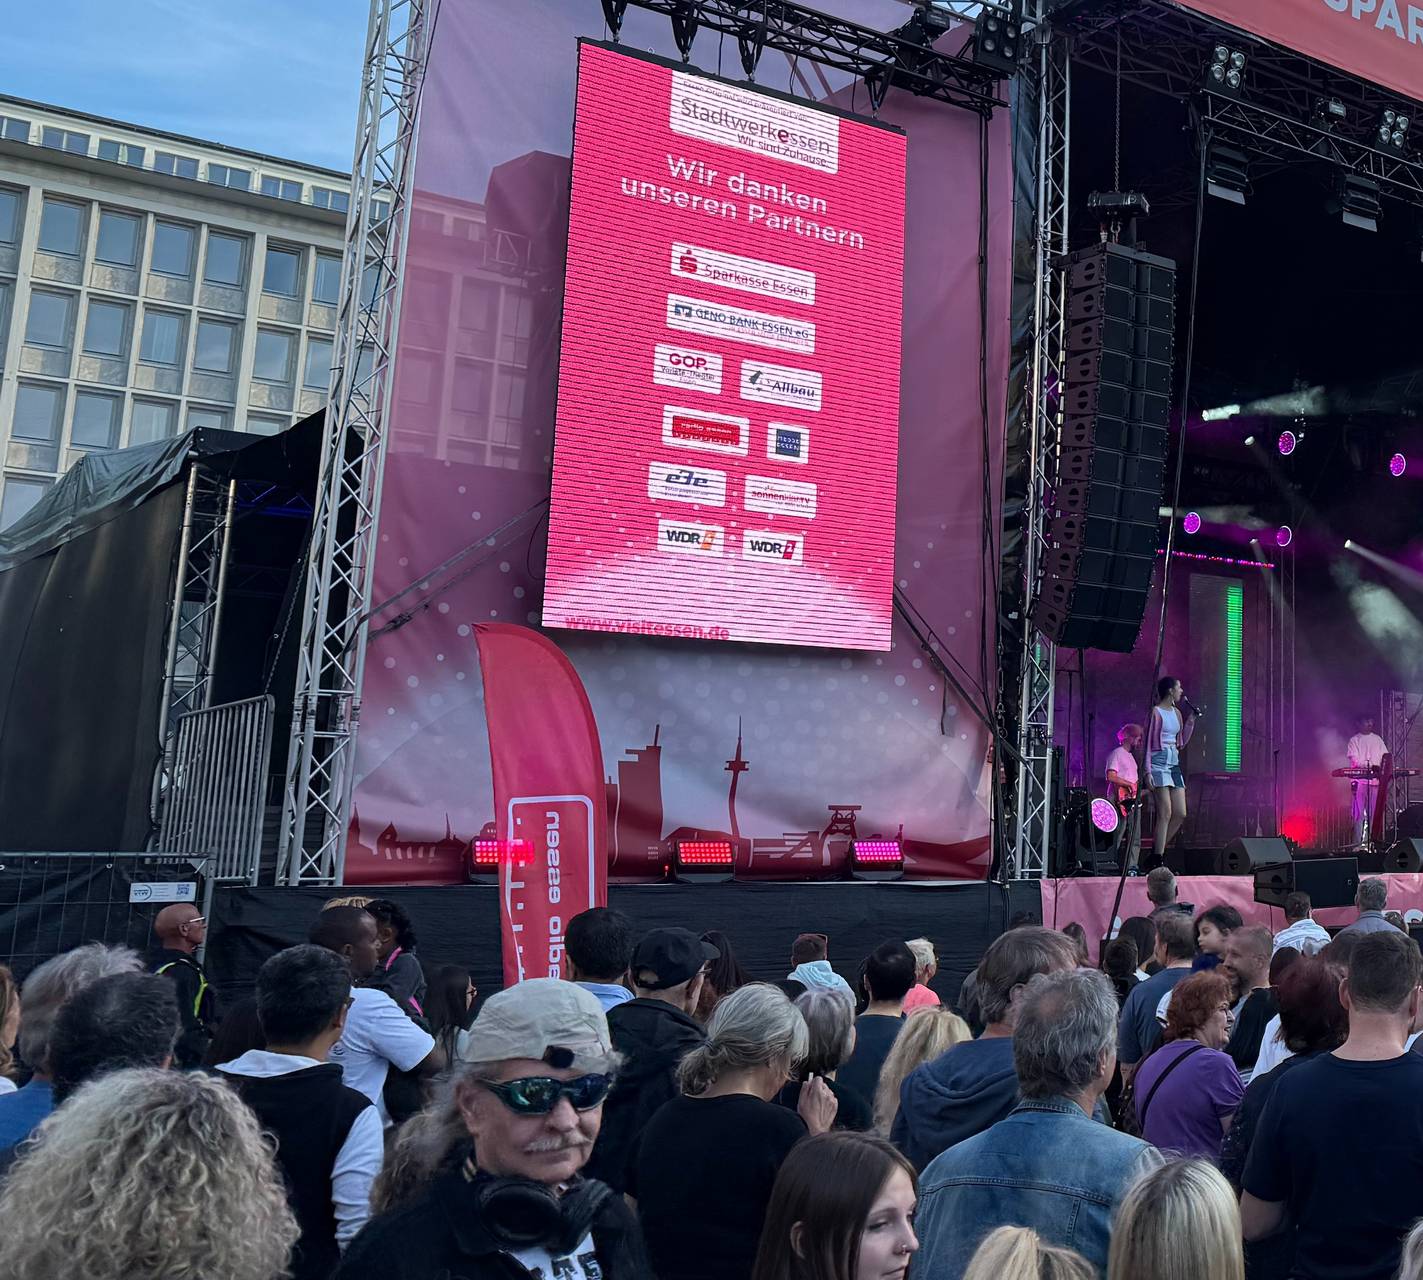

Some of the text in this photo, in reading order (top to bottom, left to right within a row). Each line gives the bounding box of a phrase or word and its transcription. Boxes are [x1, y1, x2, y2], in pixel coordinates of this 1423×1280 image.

[681, 98, 830, 154] Stadtwerkessen
[738, 132, 754, 147] Wir
[667, 153, 828, 216] Wir danken
[621, 176, 865, 249] unseren Partnern
[704, 264, 770, 289] Sparkasse
[773, 279, 808, 298] Essen
[695, 308, 727, 323] GENO
[729, 315, 760, 330] BANK
[762, 321, 793, 337] ESSEN
[666, 530, 700, 544] WDR
[750, 539, 783, 554] WDR
[565, 616, 730, 640] www.visitessen.de
